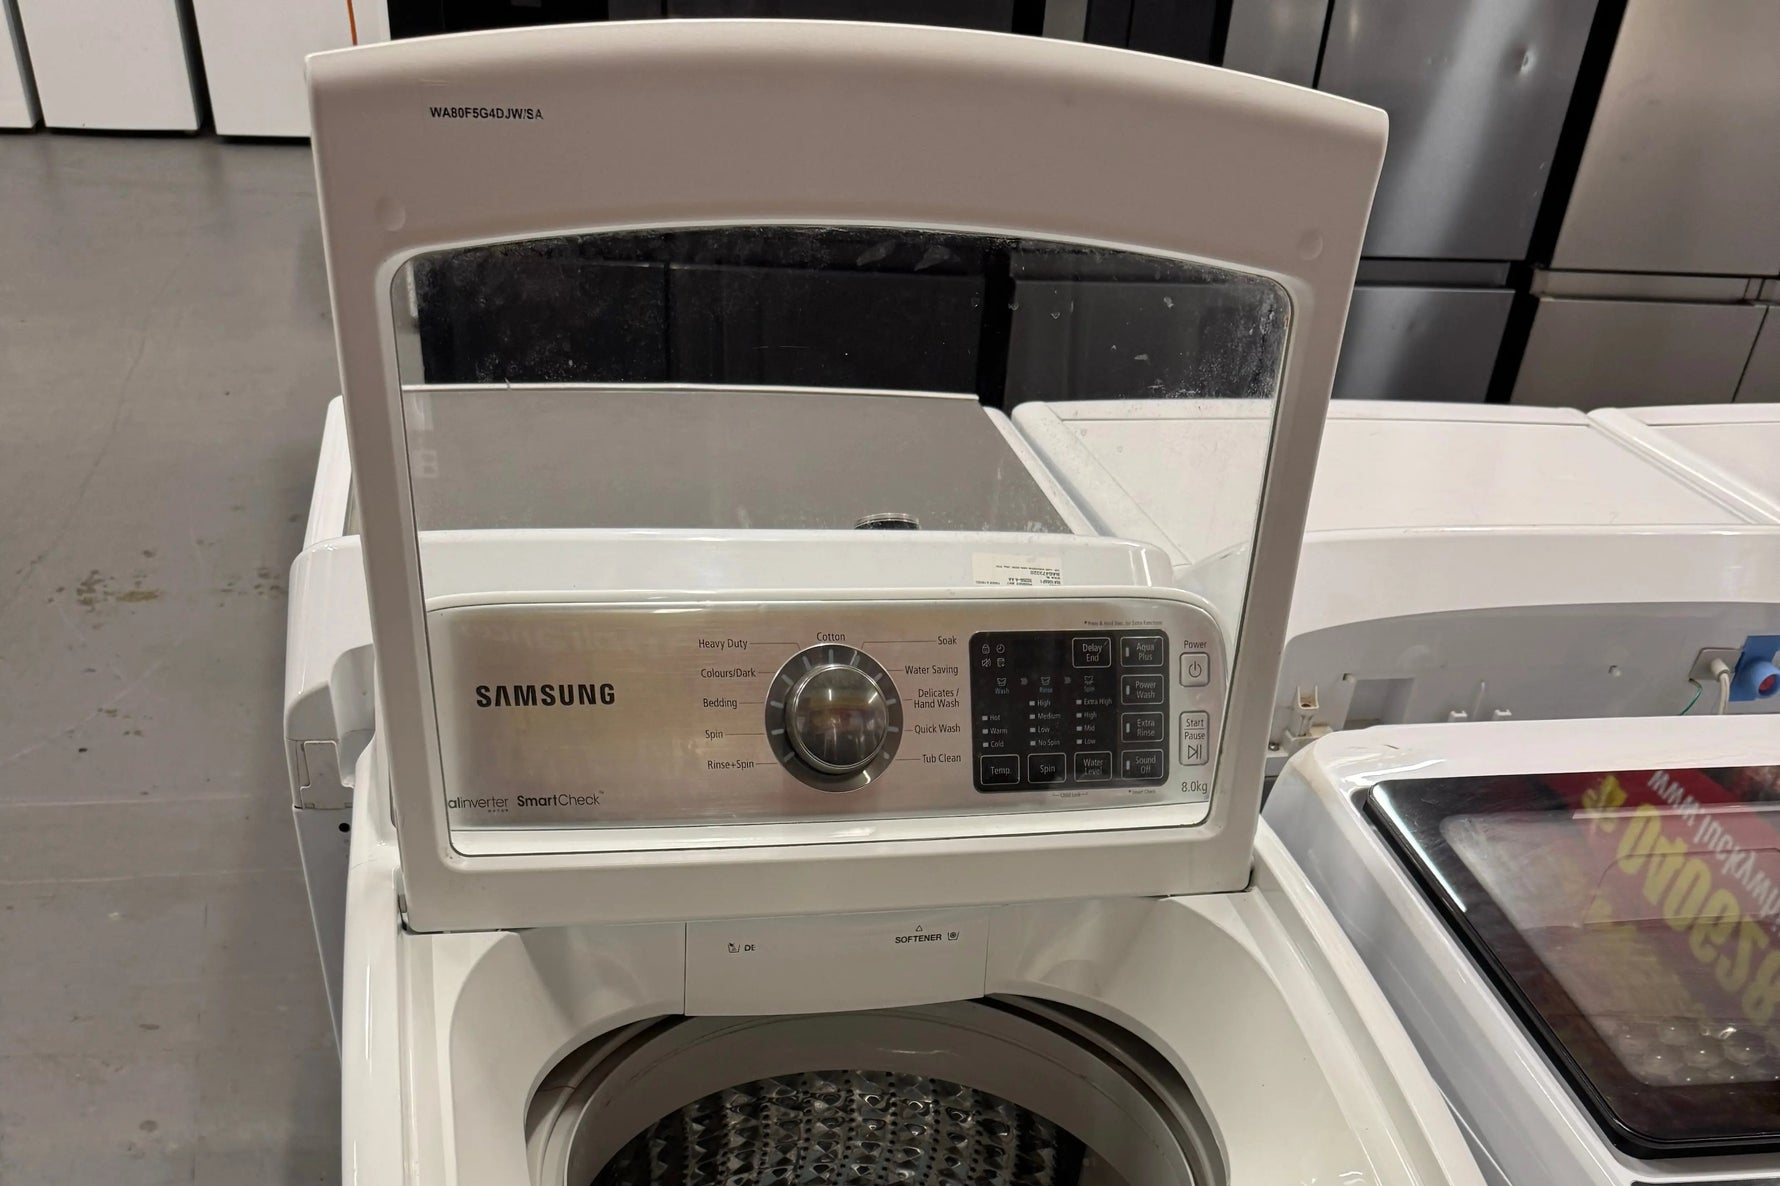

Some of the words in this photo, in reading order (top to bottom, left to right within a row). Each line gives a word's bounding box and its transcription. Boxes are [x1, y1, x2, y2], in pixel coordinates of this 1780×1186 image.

[430, 107, 544, 119] WA80F5G4DJW/SA
[816, 632, 846, 642] Cotton
[937, 636, 957, 645] Soak
[698, 639, 725, 651] Heavy
[727, 638, 748, 650] Duty
[1082, 643, 1102, 653] Delay
[1136, 642, 1155, 652] Aqua
[1183, 640, 1207, 649] Power
[1086, 653, 1099, 662] End
[1138, 652, 1153, 661] Plus
[700, 668, 756, 678] Colours/Dark
[904, 665, 929, 675] Water
[932, 665, 959, 676] Saving
[1135, 681, 1156, 689] Power
[475, 683, 616, 708] SAMSUNG
[918, 688, 954, 698] Delicates
[1136, 690, 1156, 699] Wash
[703, 698, 738, 709] Bedding
[914, 700, 936, 709] Hand
[938, 699, 960, 708] Wash
[1037, 700, 1051, 708] High
[1083, 712, 1098, 720] High
[1136, 718, 1156, 727] Extra
[1186, 718, 1204, 728] Start
[914, 724, 937, 735] Quick
[938, 723, 961, 733] Wash
[1136, 727, 1156, 736] Rinse
[705, 729, 724, 740] Spin
[1184, 731, 1206, 740] Pause
[990, 740, 1004, 748] Cold
[923, 754, 936, 763] Tub
[938, 753, 961, 763] Clean
[1083, 758, 1103, 767] Water
[1135, 755, 1157, 765] Sound
[707, 760, 754, 771] Rinse+Spin
[1039, 764, 1056, 774] Spin
[1140, 764, 1151, 774] Off
[1084, 767, 1103, 775] Level
[1181, 780, 1208, 794] 8.0kg
[517, 793, 600, 807] SmartCheck
[895, 933, 942, 943] SOFTENER
